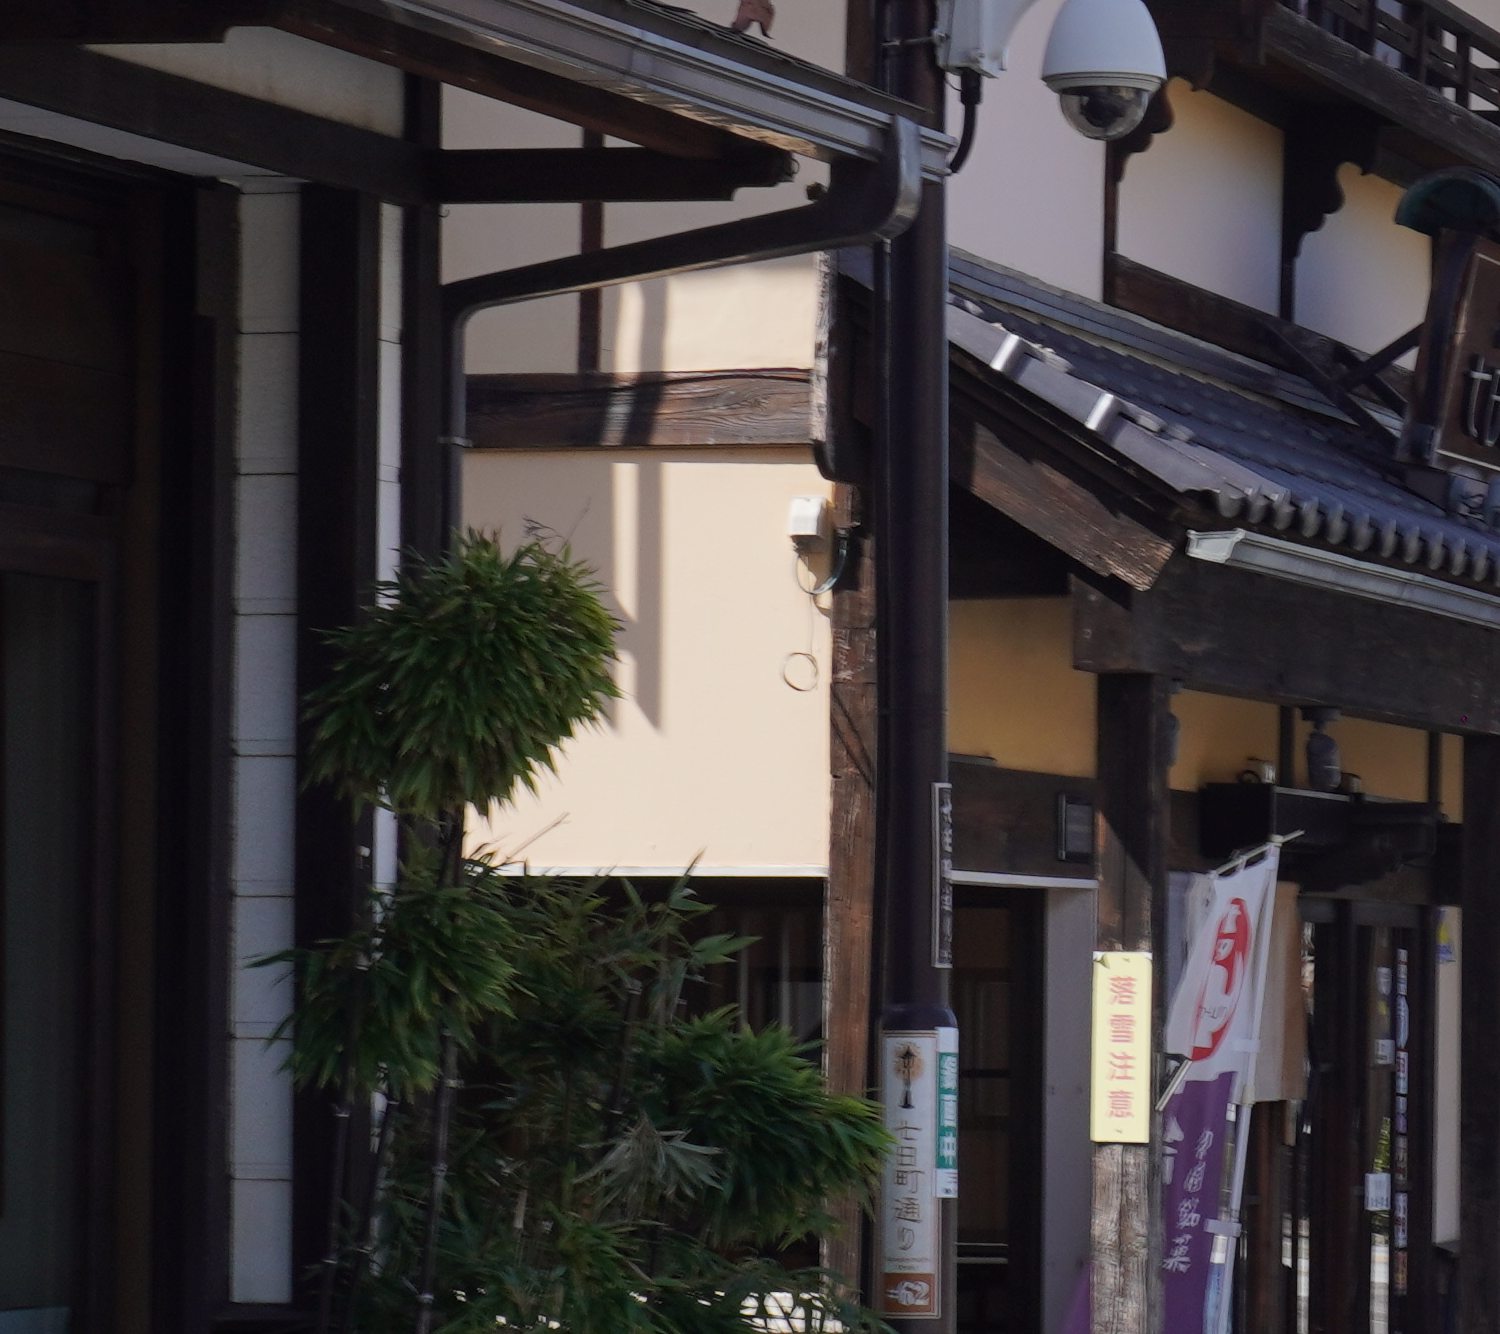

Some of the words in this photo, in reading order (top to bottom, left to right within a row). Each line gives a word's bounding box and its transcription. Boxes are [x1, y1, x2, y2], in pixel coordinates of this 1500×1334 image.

[1106, 976, 1138, 1120] 落雪注意
[894, 1120, 924, 1251] 七日町通り
